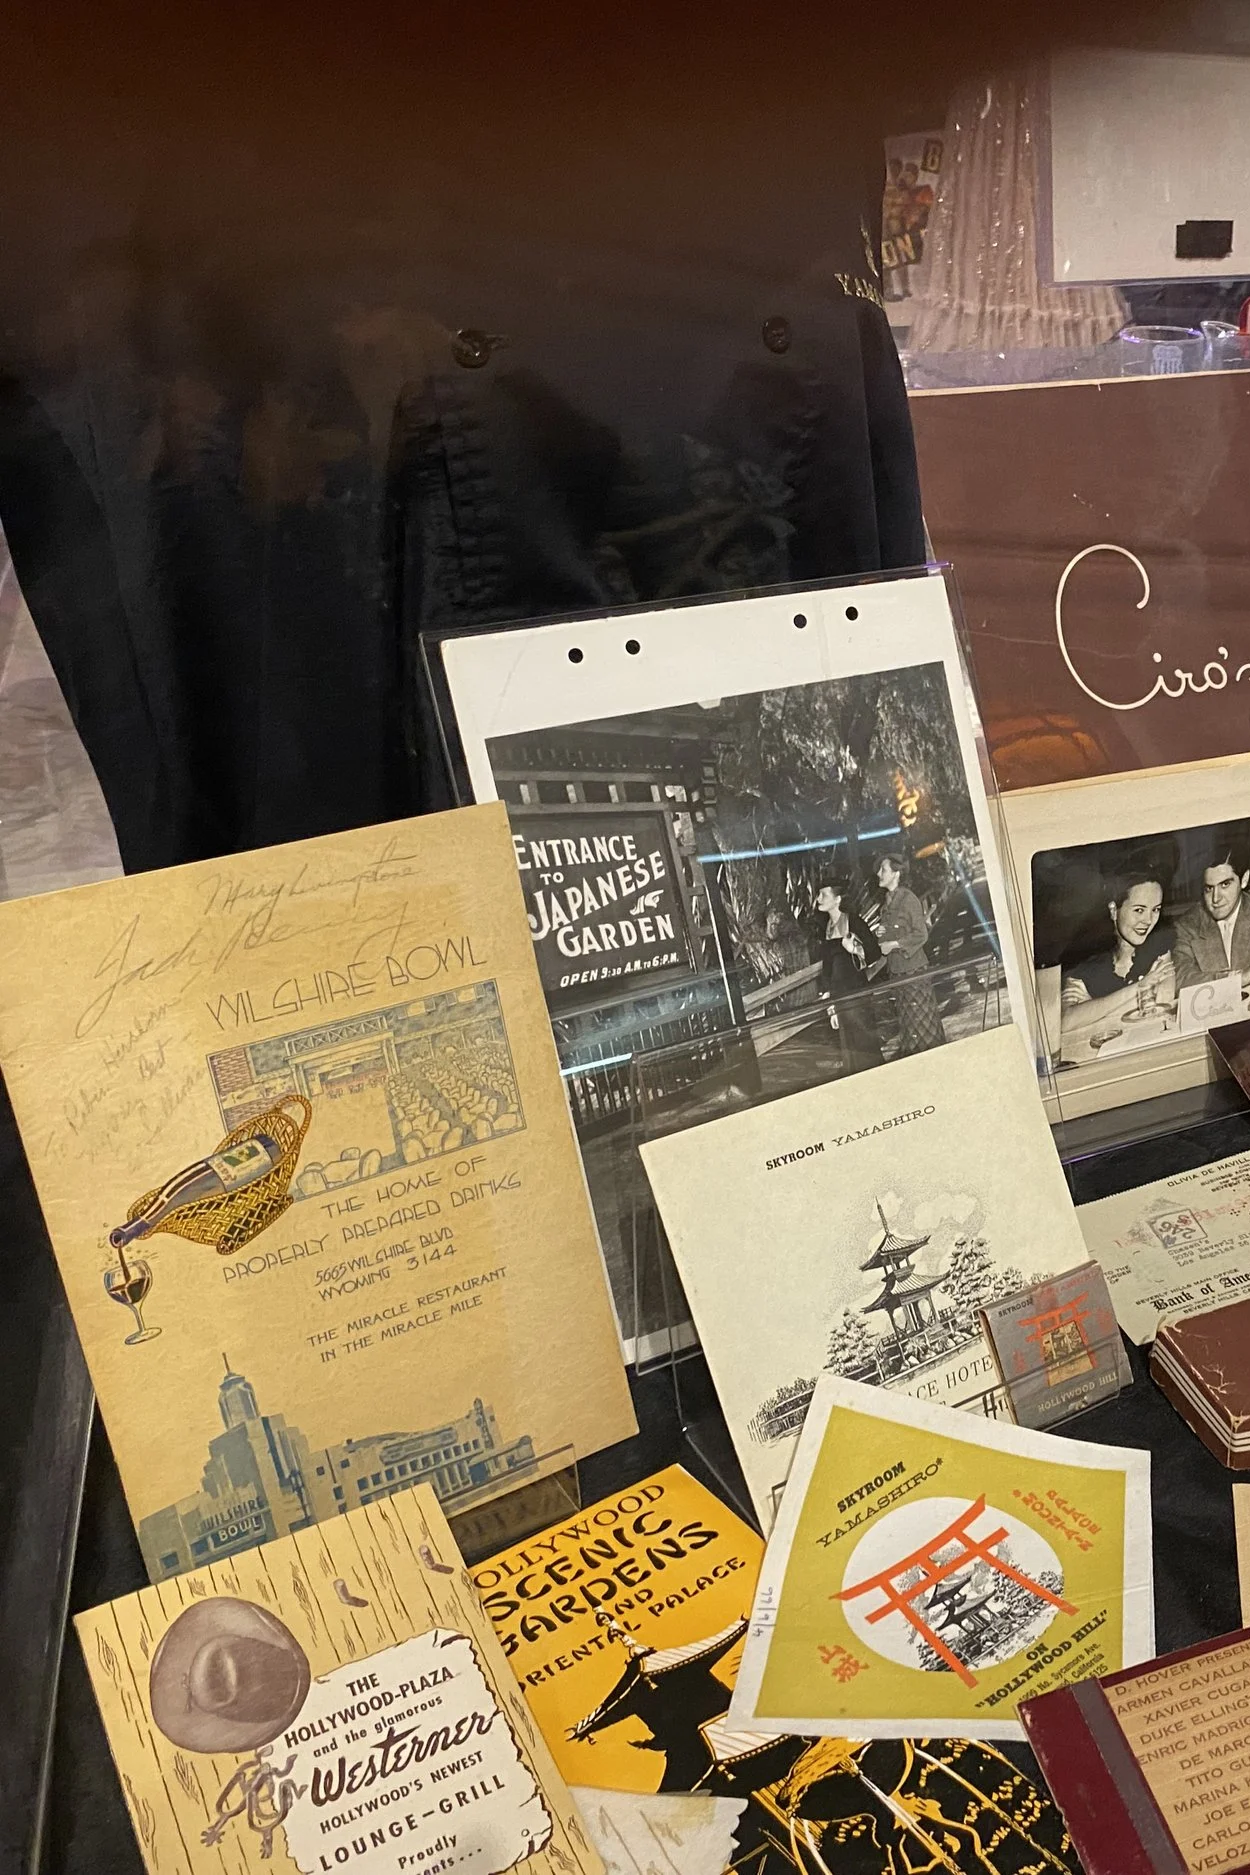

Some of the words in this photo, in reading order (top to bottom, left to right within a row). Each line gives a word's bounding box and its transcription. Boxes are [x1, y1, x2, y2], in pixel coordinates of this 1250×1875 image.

[512, 835, 637, 870] ENTRANCE
[527, 850, 666, 941] JAPANESE
[540, 871, 564, 885] TO
[556, 913, 675, 958] GARDEN
[206, 959, 376, 1030] WILSHIRE
[386, 936, 488, 987] BOWL
[560, 968, 598, 988] OPEN
[601, 967, 622, 979] 9:30
[766, 1142, 825, 1171] SKYROOM
[832, 1105, 936, 1147] YAMASHIRO
[321, 1196, 365, 1219] THE
[377, 1171, 442, 1203] HOME
[454, 1155, 487, 1177] OF
[1167, 1173, 1199, 1187] OLIVIA
[1201, 1168, 1215, 1177] DE
[222, 1234, 330, 1284] PROPERLY
[342, 1200, 441, 1244] PREPARED
[450, 1171, 522, 1209] DRINKS
[315, 1262, 347, 1287] 5665
[347, 1239, 414, 1274] WILSHIRE
[421, 1226, 454, 1248] BLVD
[318, 1266, 391, 1302] WYOMING
[407, 1244, 458, 1271] 3144
[307, 1328, 338, 1348] THE
[347, 1302, 411, 1334] MIRACLE
[417, 1266, 508, 1307] RESTAURANT
[1150, 1290, 1195, 1313] Bank
[1200, 1283, 1215, 1296] of
[320, 1349, 337, 1363] IN
[342, 1335, 374, 1355] THE
[381, 1309, 442, 1341] MIRACLE
[450, 1295, 483, 1316] MILE
[1037, 1382, 1096, 1413] HOLLYWOOD
[1099, 1372, 1119, 1388] HILL
[836, 1459, 907, 1515] SKYROOM
[219, 1516, 260, 1541] BOWL
[1046, 1490, 1101, 1535] PALACE
[473, 1484, 666, 1590] OLLYWOOD
[482, 1510, 673, 1623] SCENIC
[595, 1587, 656, 1628] AND
[648, 1556, 747, 1619] PALACE
[1026, 1642, 1049, 1661] ON
[1071, 1652, 1105, 1680] California
[346, 1673, 381, 1697] THE
[1114, 1685, 1132, 1697] D.
[1135, 1663, 1191, 1690] HOVER
[284, 1666, 455, 1749] HOLLYWOOD-PLAZA
[312, 1737, 339, 1759] and
[345, 1727, 368, 1745] the
[374, 1695, 444, 1733] glamorous
[1143, 1696, 1201, 1725] XAVIER
[1138, 1739, 1188, 1766] ENRIC
[1140, 1721, 1186, 1746] DUKE
[310, 1711, 494, 1807] Westerner
[1179, 1754, 1204, 1771] DE
[1185, 1767, 1224, 1789] TITO
[319, 1778, 424, 1835] HOLLYWOOD'S
[429, 1750, 485, 1784] NEWEST
[1174, 1782, 1240, 1815] MARINA
[1202, 1804, 1236, 1826] JOE
[397, 1833, 458, 1870] Proudly
[1191, 1843, 1250, 1872] VELOZ
